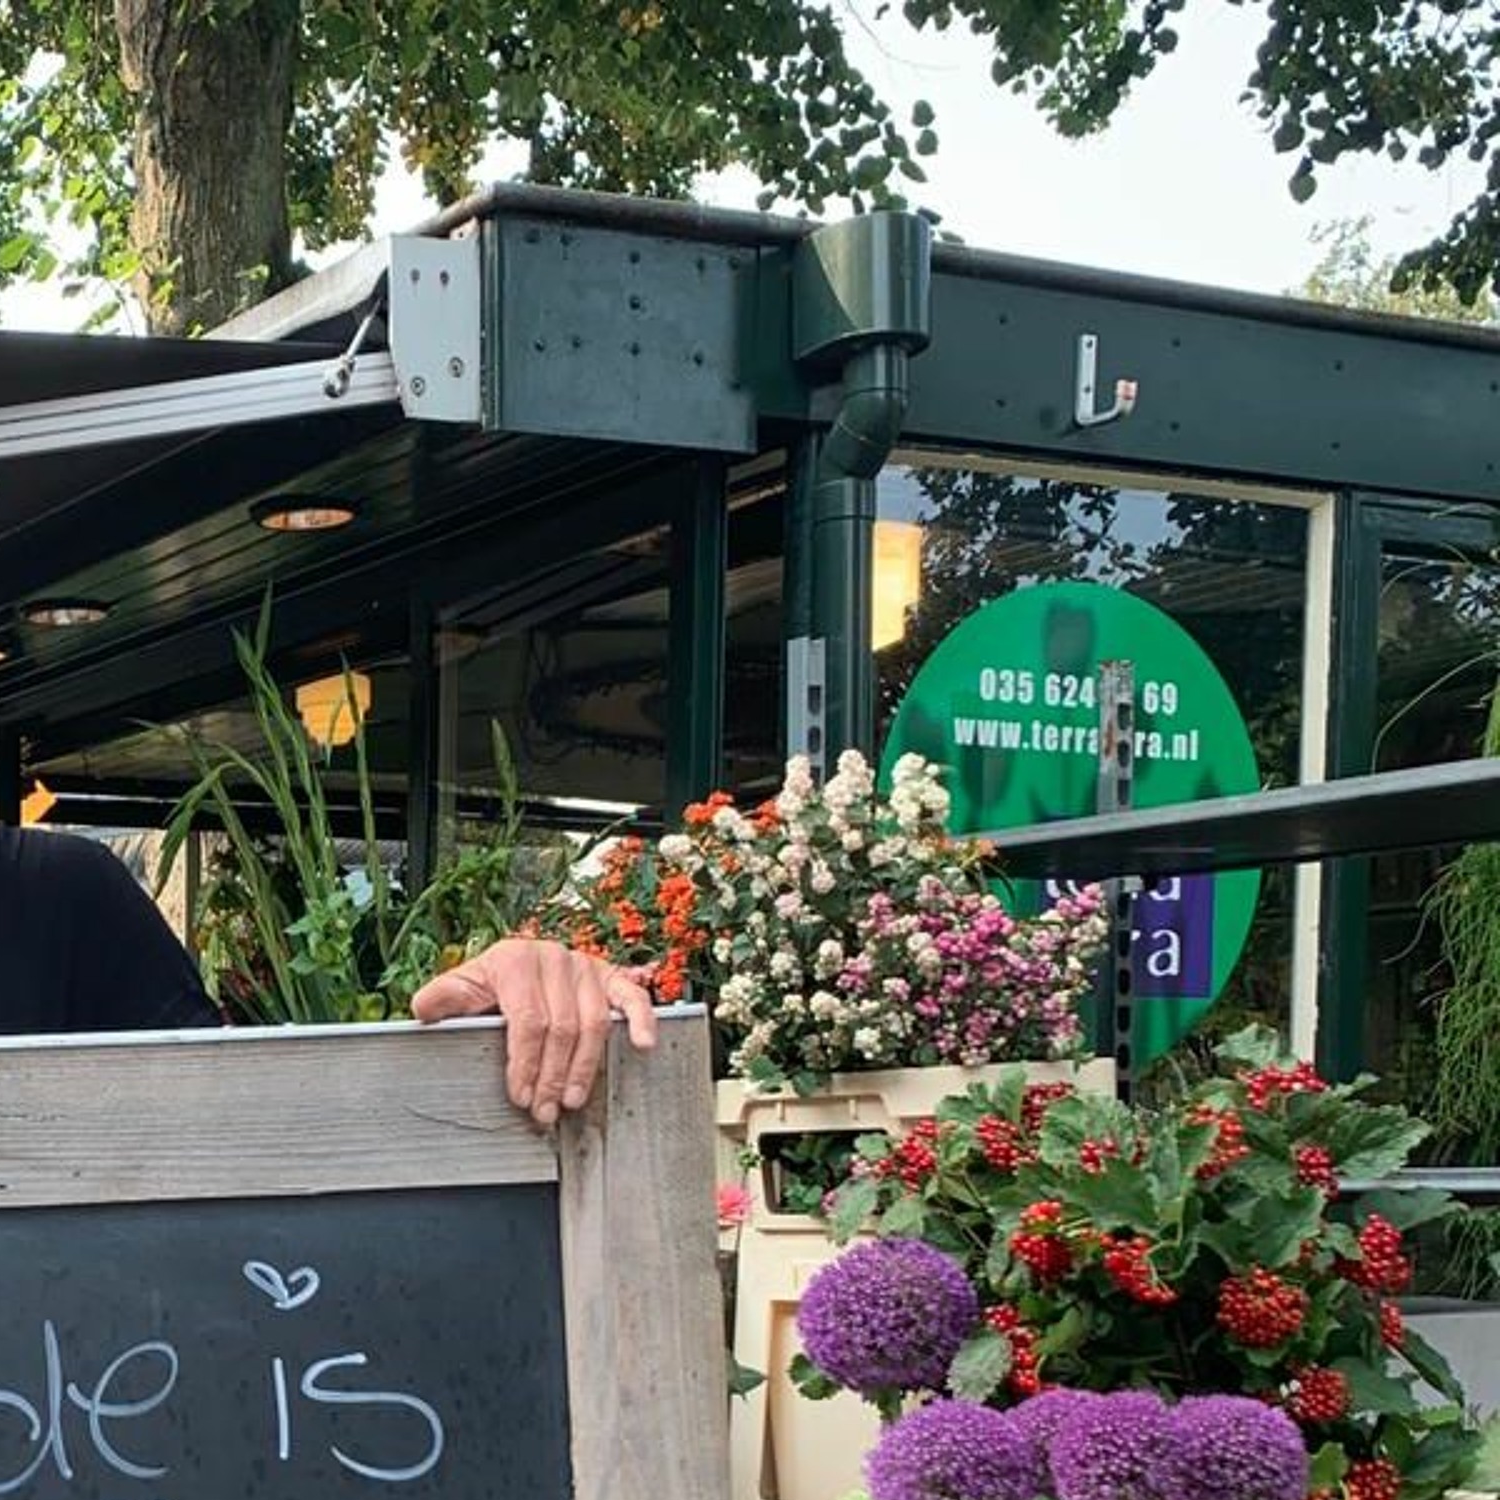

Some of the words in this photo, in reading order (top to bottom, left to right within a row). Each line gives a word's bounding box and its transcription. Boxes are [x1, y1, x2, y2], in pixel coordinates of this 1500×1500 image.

[979, 667, 1034, 704] 035
[1044, 672, 1097, 709] 624
[1142, 681, 1178, 716] 69
